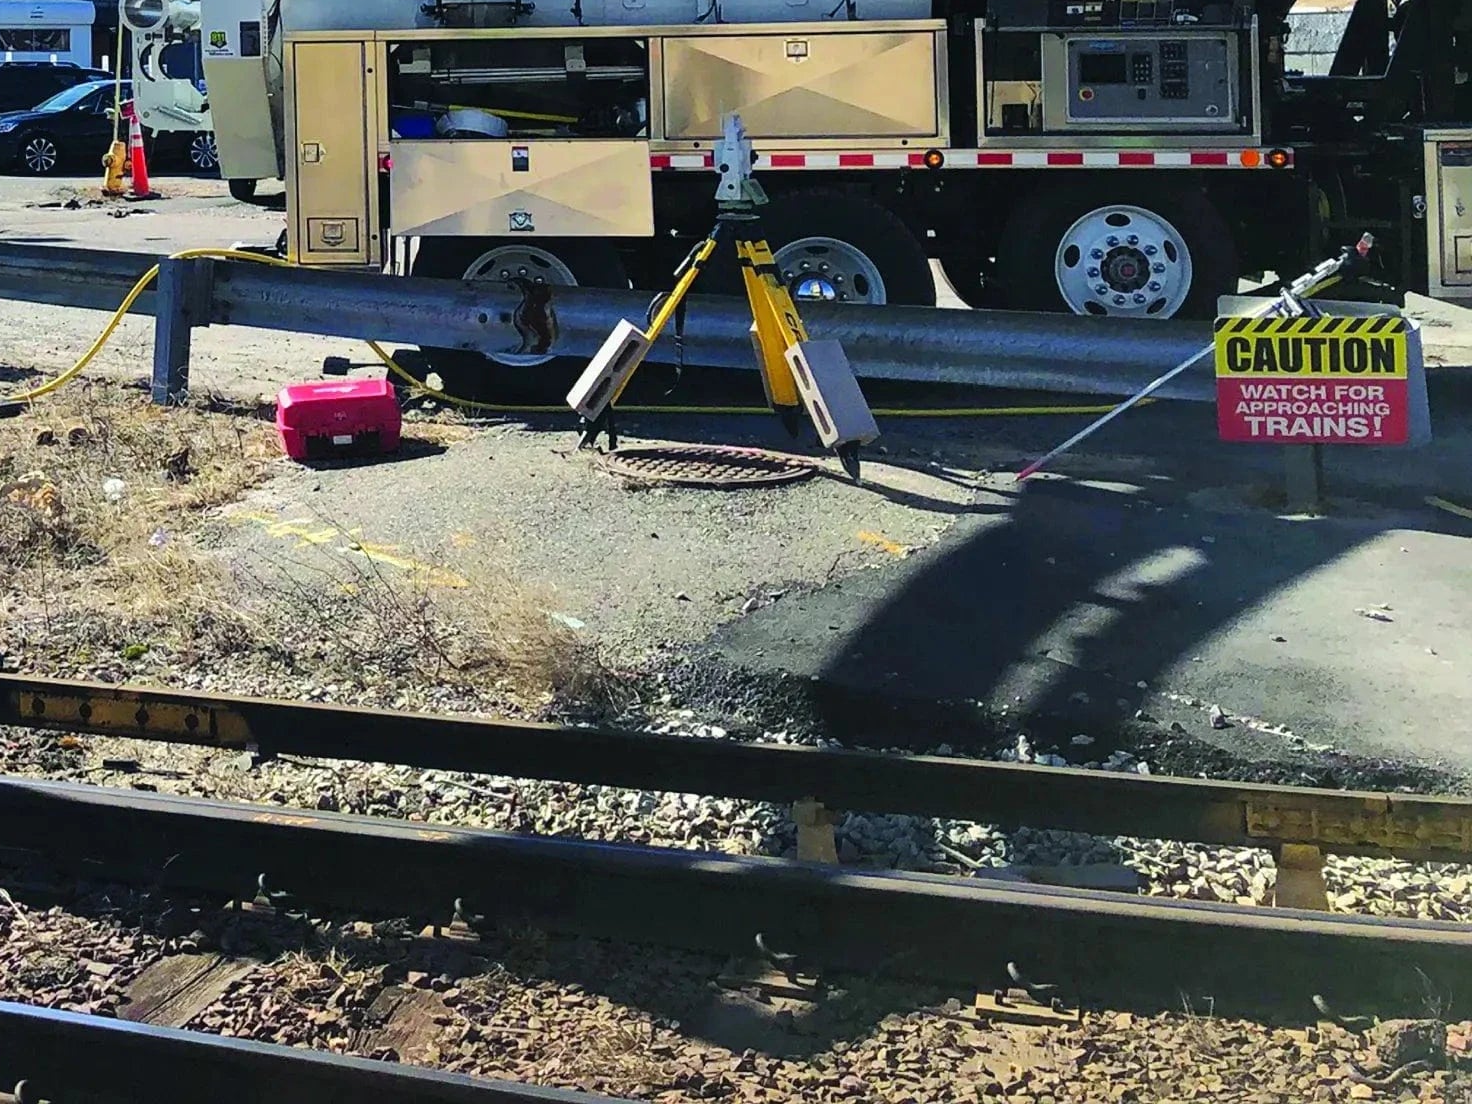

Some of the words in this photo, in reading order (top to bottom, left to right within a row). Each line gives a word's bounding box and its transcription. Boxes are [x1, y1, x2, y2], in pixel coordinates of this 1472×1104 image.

[211, 32, 225, 42] 811
[1226, 336, 1395, 373] CAUTION
[1240, 384, 1327, 400] WATCH
[1334, 385, 1385, 400] FOR
[1235, 401, 1390, 416] APPROACHING
[1244, 416, 1383, 437] TRAINS!
